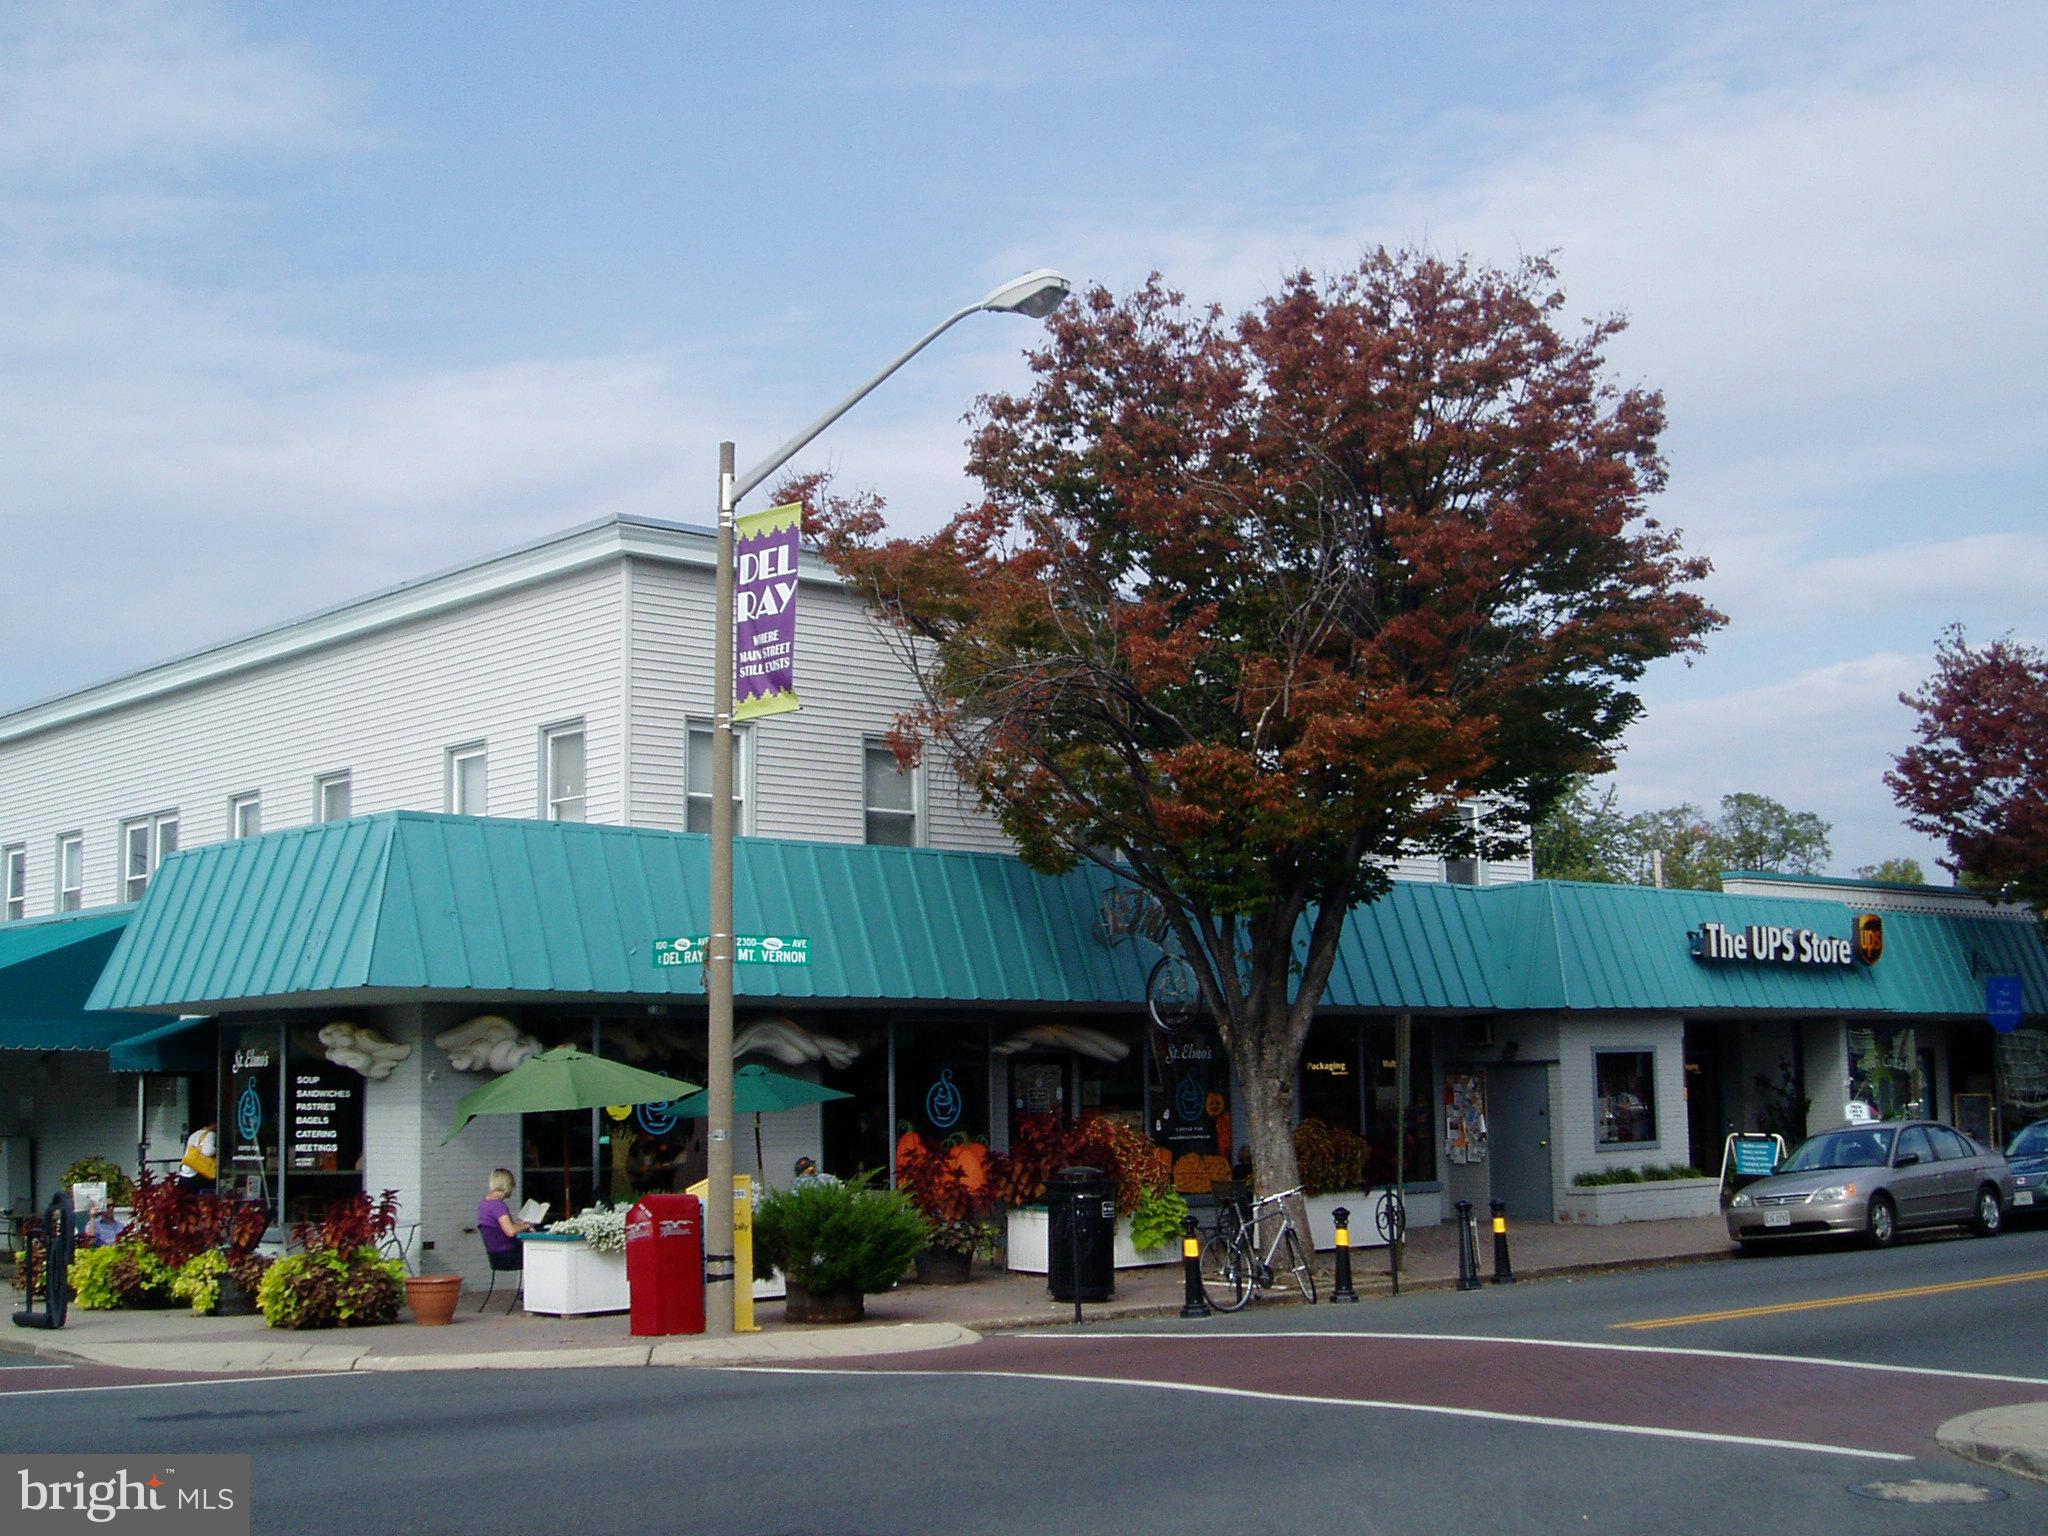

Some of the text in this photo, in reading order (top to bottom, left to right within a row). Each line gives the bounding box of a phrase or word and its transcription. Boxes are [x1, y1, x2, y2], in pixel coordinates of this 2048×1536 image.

[739, 545, 797, 585] DEL
[737, 580, 797, 623] RAY
[753, 630, 779, 646] WHERE
[740, 642, 790, 663] MAIN STREET
[739, 657, 790, 678] STILL EXISTS
[736, 937, 756, 947] 2300
[792, 939, 807, 948] AVE
[1706, 923, 1851, 964] The UPS Store
[1861, 930, 1881, 952] ups
[663, 952, 681, 965] DEL
[684, 950, 704, 964] RAY
[738, 949, 806, 963] MT. VERNON
[1182, 1044, 1213, 1060] Elmo's
[1307, 1061, 1346, 1071] Packaging
[296, 1076, 320, 1085] SOUP
[296, 1089, 351, 1098] SANDWICHES
[296, 1103, 336, 1111] PASTRIES
[295, 1116, 329, 1125] BAGELS
[295, 1130, 337, 1139] CATERING
[295, 1144, 338, 1153] MEETINGS
